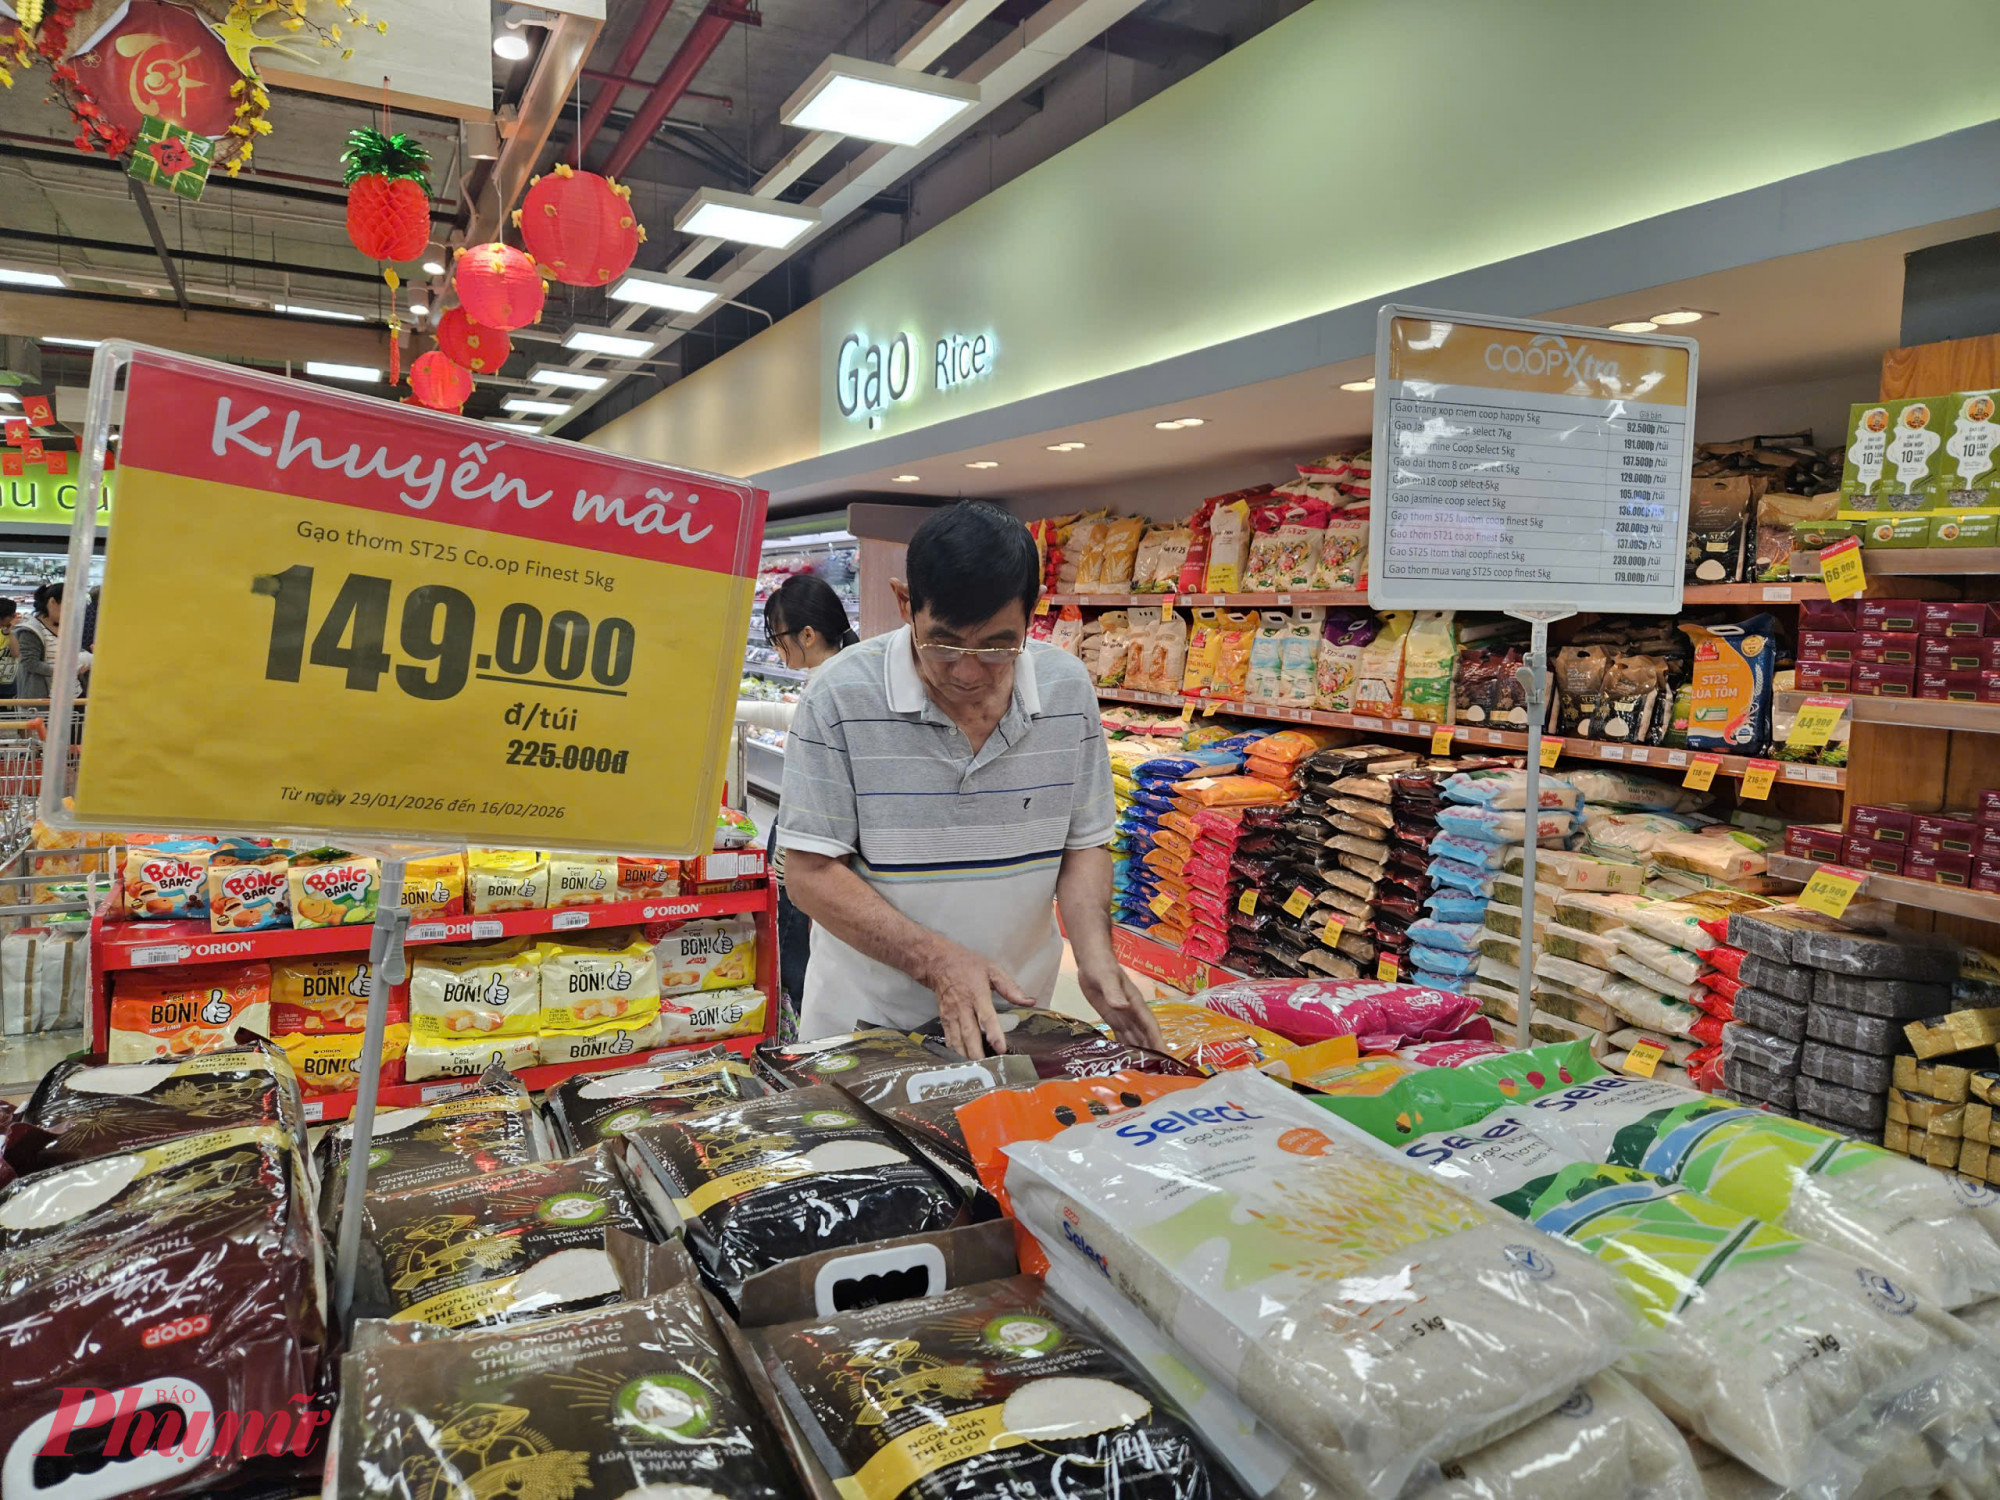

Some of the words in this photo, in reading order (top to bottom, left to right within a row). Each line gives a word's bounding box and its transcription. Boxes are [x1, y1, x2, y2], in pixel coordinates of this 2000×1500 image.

[837, 332, 909, 429] Gạo
[935, 332, 986, 388] Rice
[1395, 403, 1412, 413] Gao
[1479, 411, 1498, 421] coop
[1501, 412, 1525, 424] happy
[1527, 414, 1541, 425] 5kg
[1473, 427, 1496, 438] select
[1498, 429, 1512, 441] 7kg
[1452, 443, 1473, 454] Coop
[1475, 445, 1499, 456] Select
[1501, 447, 1516, 458] 5kg
[1862, 453, 1874, 465] 10
[1901, 450, 1913, 463] 10
[1963, 444, 1976, 456] 10
[211, 395, 554, 514] Khuyến
[572, 486, 714, 546] mãi
[1393, 457, 1411, 467] Gao
[1413, 458, 1426, 468] dai
[1428, 460, 1450, 470] thom
[1452, 462, 1458, 470] 8
[1506, 465, 1520, 477] 5kg
[1438, 478, 1458, 489] coop
[1392, 493, 1409, 503] Gao
[1410, 494, 1443, 506] jasmine
[1445, 496, 1464, 508] coop
[1467, 497, 1490, 508] select
[1492, 498, 1506, 509] 5kg
[1391, 511, 1409, 521] Gao
[1410, 512, 1433, 522] thom
[1435, 513, 1454, 523] ST25
[1486, 517, 1505, 527] coop
[1507, 515, 1528, 526] finest
[1530, 517, 1544, 529] 5kg
[1391, 529, 1407, 539] Gao
[1409, 530, 1432, 540] thom
[1433, 531, 1453, 541] ST21
[1455, 534, 1475, 544] coop
[1477, 532, 1498, 543] finest
[1500, 534, 1514, 545] 5kg
[297, 517, 341, 550] Gạo
[345, 524, 404, 554] thơm
[409, 538, 459, 565] ST25
[462, 544, 521, 576] Co.op
[524, 558, 581, 585] Finest
[583, 569, 617, 593] 5kg
[1389, 547, 1407, 557] Gao
[1409, 547, 1428, 557] ST25
[1451, 549, 1467, 558] thai
[1469, 549, 1510, 561] coopfinest
[1511, 551, 1525, 562] 5kg
[1389, 565, 1406, 575] Gao
[1408, 565, 1430, 575] thom
[1431, 567, 1450, 576] mua
[1452, 568, 1471, 578] vang
[1472, 567, 1492, 577] ST25
[1494, 569, 1513, 579] coop
[1514, 568, 1536, 578] finest
[1538, 569, 1551, 580] 5kg
[252, 563, 636, 702] 149.000
[1700, 674, 1729, 685] ST25
[1715, 687, 1738, 699] TÔM
[503, 699, 579, 732] đ/túi
[506, 737, 630, 776] 225.000đ
[280, 784, 302, 802] Từ
[304, 788, 347, 806] ngày
[350, 790, 444, 812] 29/01/2026
[448, 797, 477, 815] đến
[479, 799, 566, 819] 16/02/2026
[159, 875, 194, 889] BANG
[561, 876, 589, 891] BON!
[625, 867, 652, 883] BON!
[242, 886, 277, 902] BANG
[324, 882, 358, 898] BANG
[487, 883, 518, 898] BON!
[654, 902, 702, 919] ORION
[198, 938, 253, 959] ORION
[680, 940, 713, 957] BON!
[302, 976, 347, 998] BON!
[569, 974, 606, 994] BON!
[443, 983, 481, 1004] BON!
[150, 1003, 199, 1026] BON!
[689, 1007, 721, 1027] BON!
[569, 1042, 608, 1060] BON!
[303, 1056, 349, 1076] BON!
[1116, 1100, 1265, 1147] Select
[1063, 1220, 1111, 1279] Select
[424, 1300, 460, 1315] NGON
[145, 1317, 208, 1346] COOP
[578, 1325, 600, 1338] ST
[603, 1321, 625, 1333] 25
[1411, 1322, 1426, 1337] 5
[1421, 1315, 1447, 1334] kg
[1814, 1333, 1841, 1354] kg
[907, 1428, 949, 1450] NGON
[949, 1428, 986, 1446] GIỚI
[941, 1444, 975, 1462] 2019
[995, 1482, 1008, 1495] 5
[1009, 1479, 1037, 1497] kg
